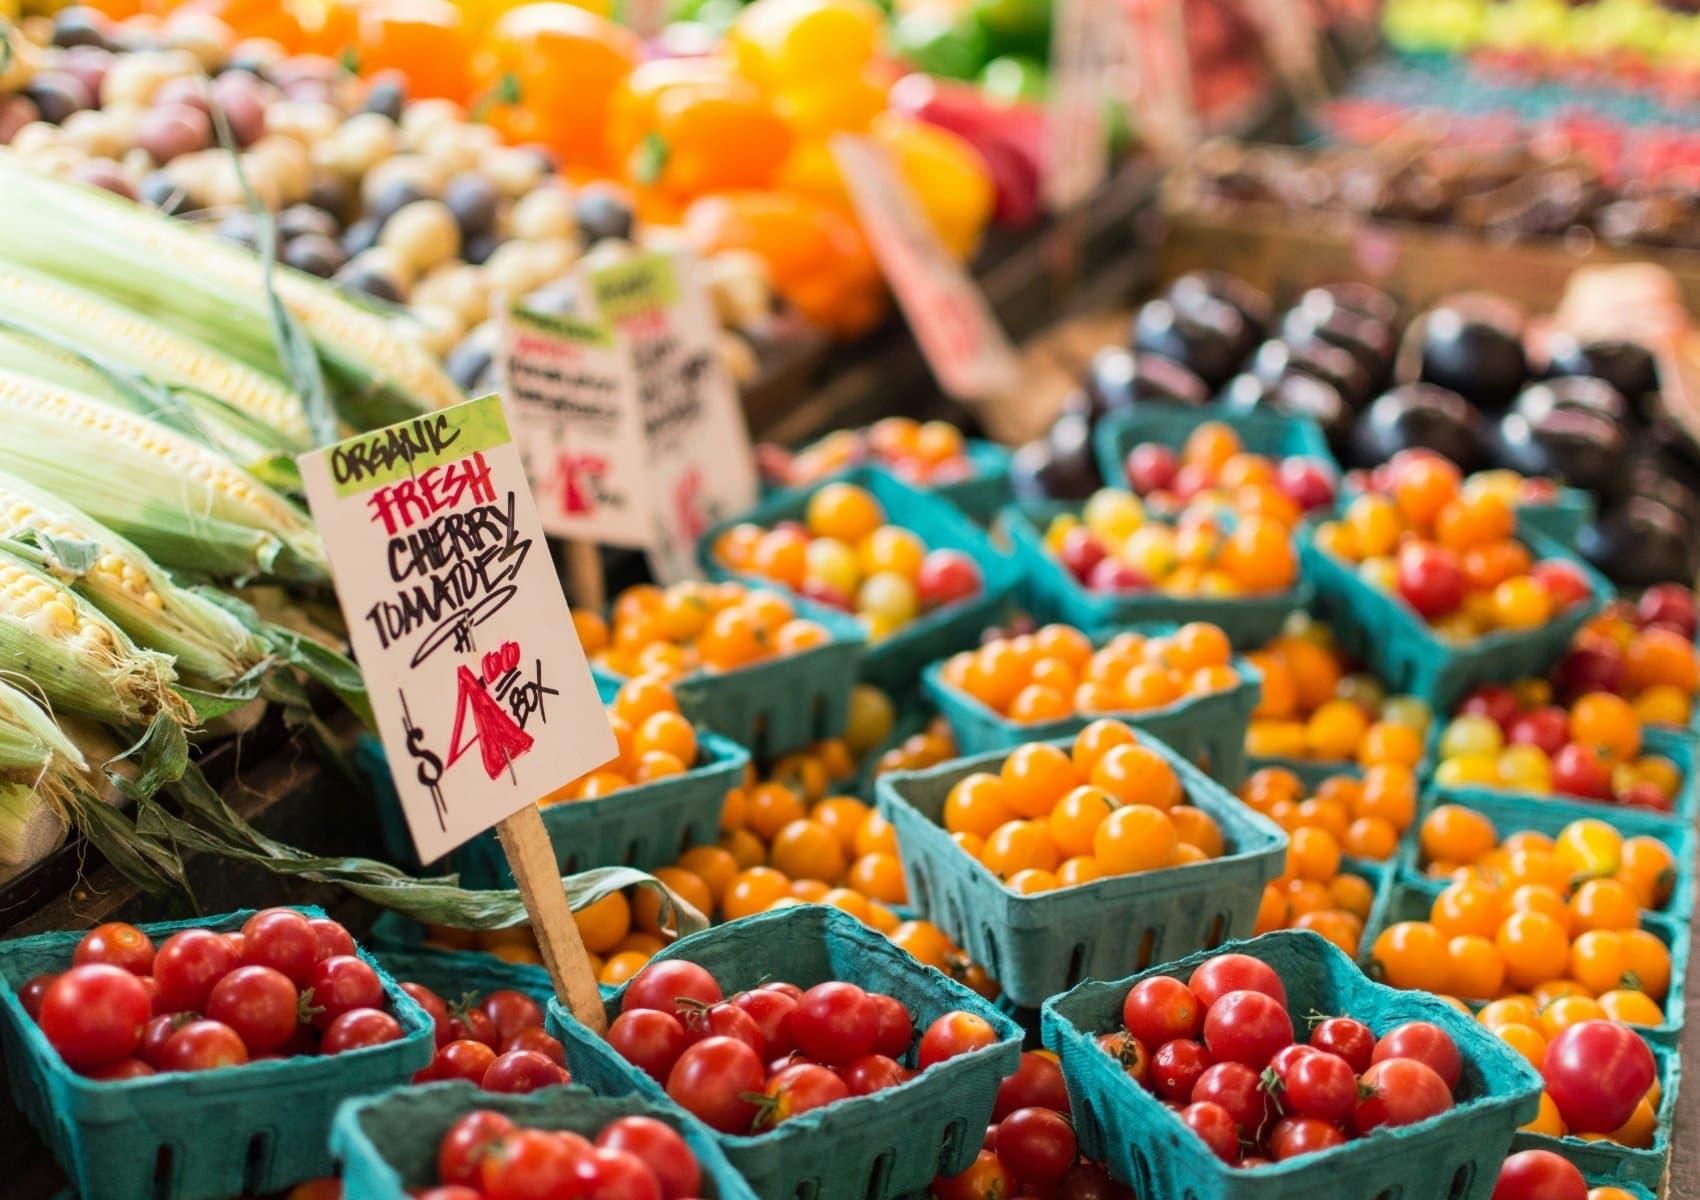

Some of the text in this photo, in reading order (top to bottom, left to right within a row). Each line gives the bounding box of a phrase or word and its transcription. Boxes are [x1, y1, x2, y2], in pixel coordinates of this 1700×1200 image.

[332, 415, 460, 485] ORGANIC
[367, 451, 497, 536] FRESH
[388, 491, 518, 582] CHERRY
[366, 537, 532, 649] TOMATOES
[510, 659, 560, 729] BOX
